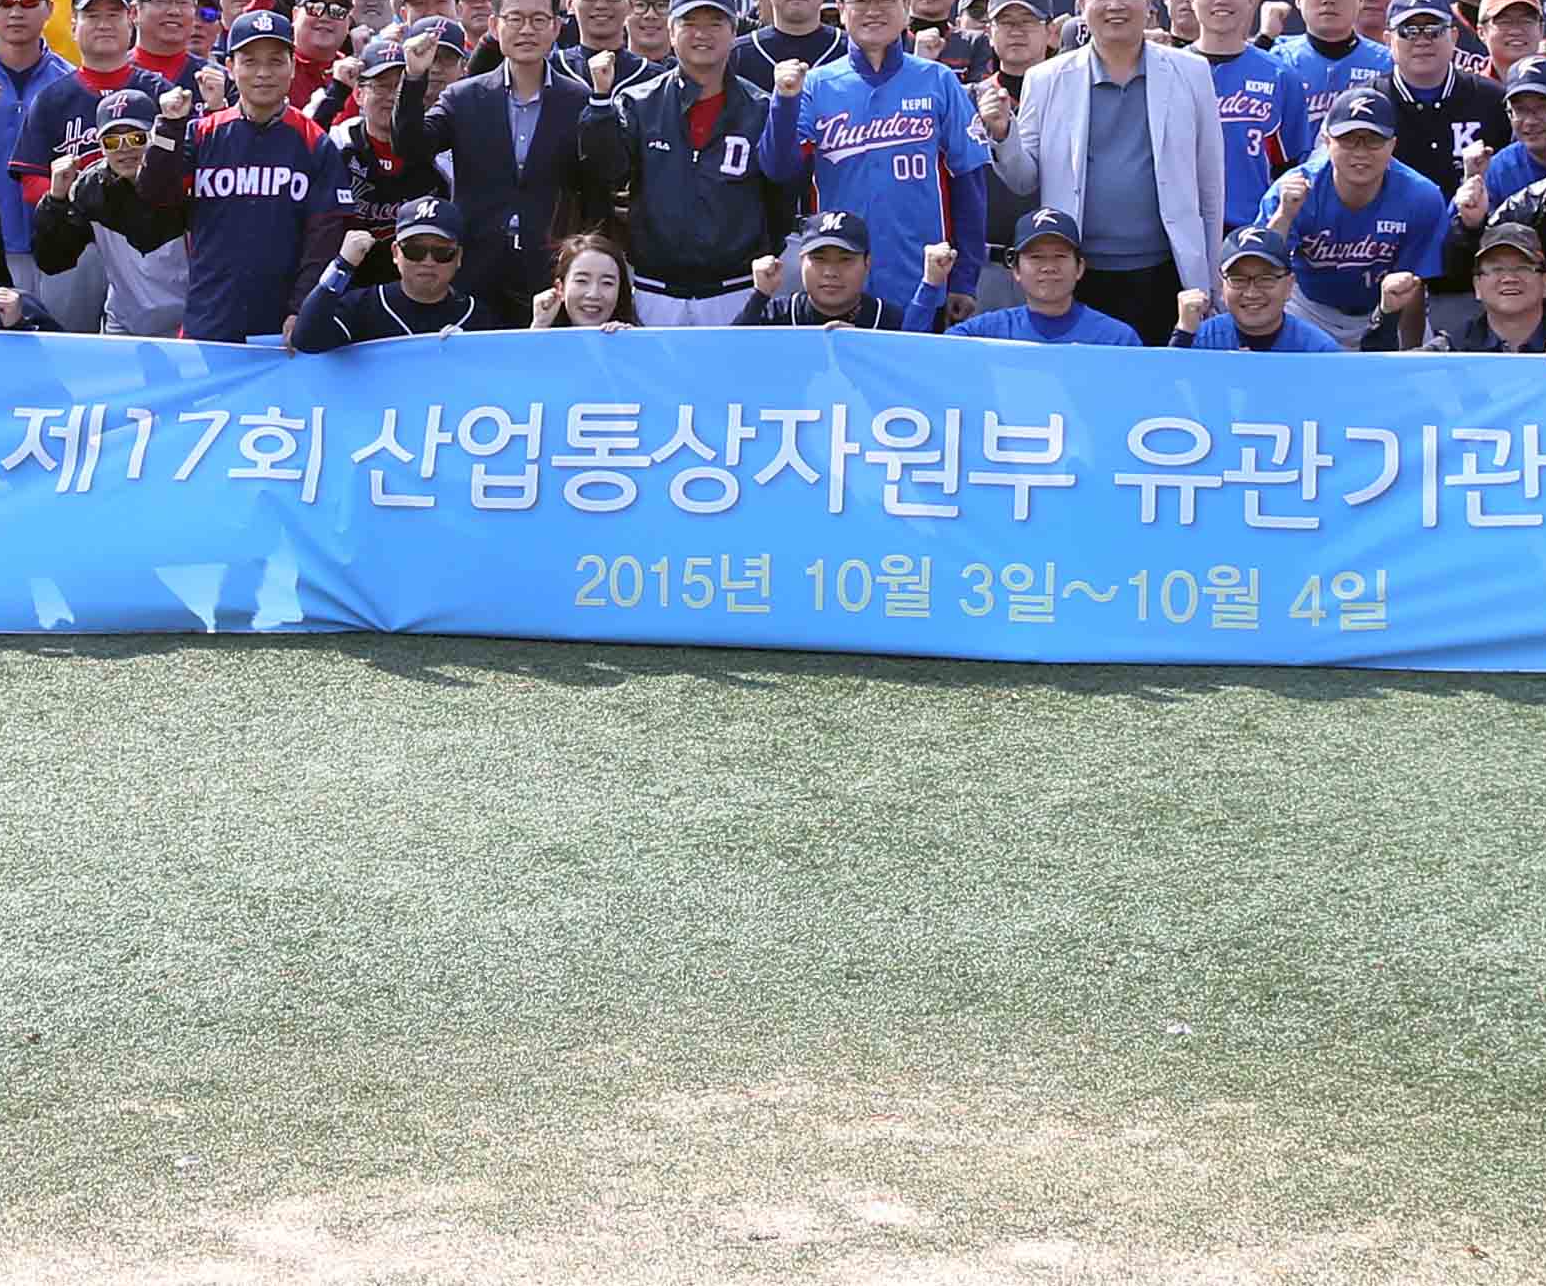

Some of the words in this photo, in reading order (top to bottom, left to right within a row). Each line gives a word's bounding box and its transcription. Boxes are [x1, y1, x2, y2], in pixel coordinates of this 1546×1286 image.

[901, 98, 932, 112] KEPRI
[815, 110, 934, 155] Thunders
[1246, 128, 1262, 157] 3
[719, 135, 751, 177] D
[893, 154, 927, 181] 00
[195, 165, 310, 202] KOMIPO
[415, 200, 439, 220] M
[819, 211, 846, 232] M
[1376, 220, 1407, 234] KEPRI
[1, 403, 325, 504] 제17회
[351, 401, 1076, 521] 산업통상자원부
[574, 553, 772, 614] 2015년
[805, 554, 932, 618] 10월
[1289, 568, 1389, 632] 4일
